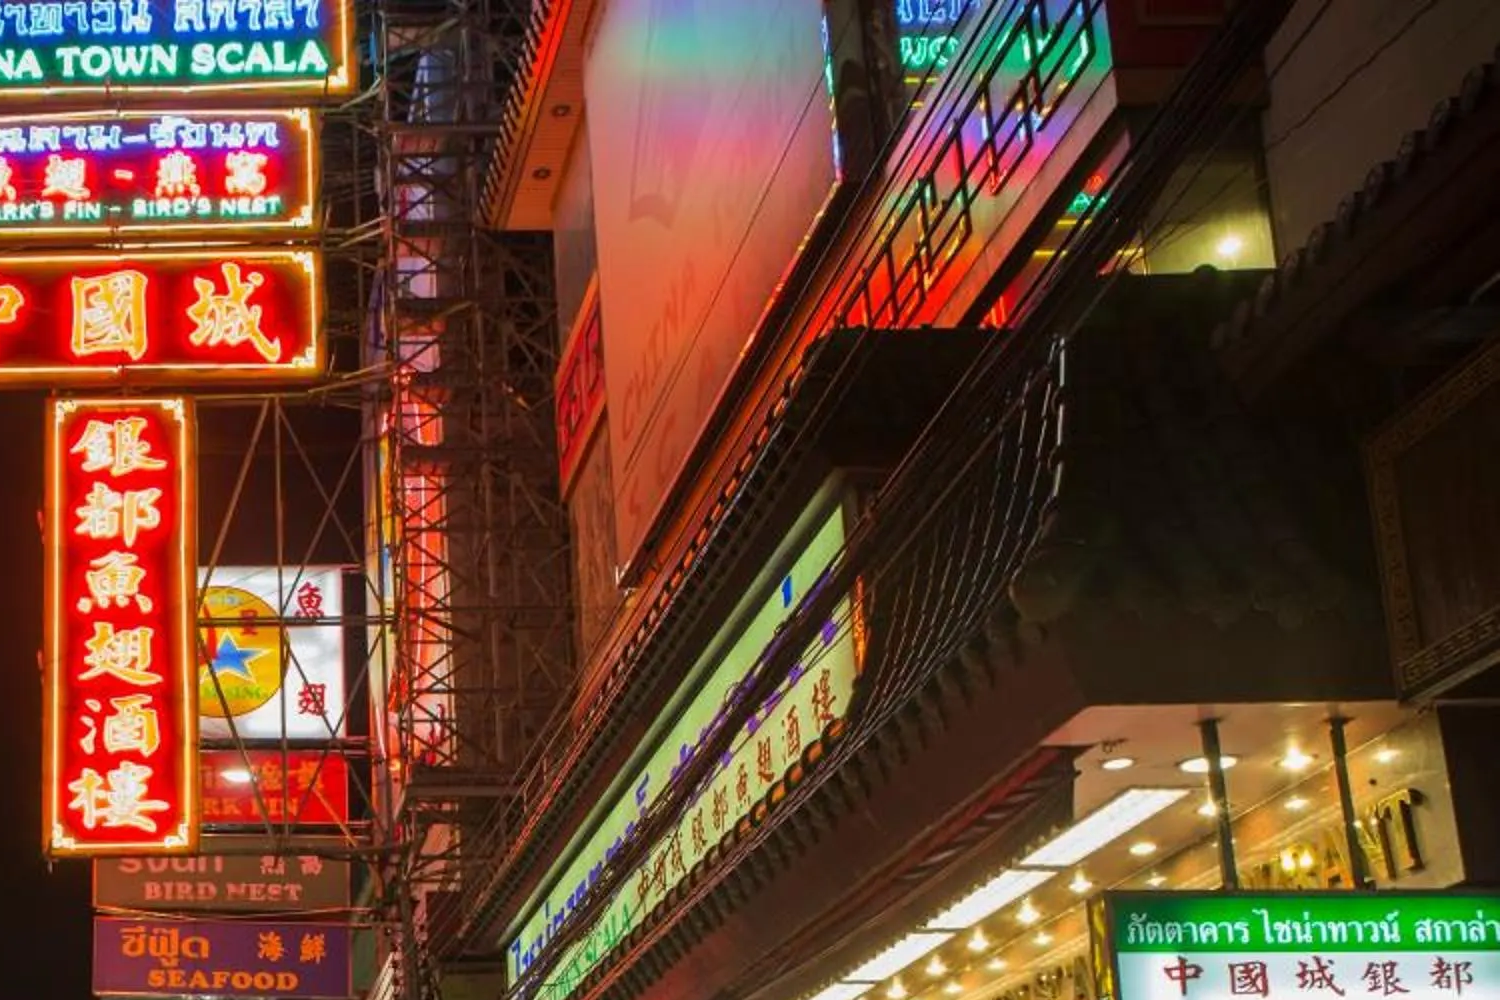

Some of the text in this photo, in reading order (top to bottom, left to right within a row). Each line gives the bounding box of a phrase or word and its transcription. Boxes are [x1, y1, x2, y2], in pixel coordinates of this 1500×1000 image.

[55, 45, 178, 77] TOWN
[190, 41, 328, 75] SCALA
[64, 202, 100, 219] FIN
[133, 197, 211, 217] BIRD'S
[220, 196, 281, 215] NEST
[68, 417, 169, 832] 銀都魚翅酒樓
[145, 882, 303, 900] BIRD NEST
[1126, 909, 1500, 944] ภัตตาคาร ไชน่าทาวน์ สกาล่า
[258, 931, 326, 963] 海鮮
[148, 971, 299, 990] SEAFOOD
[1164, 955, 1473, 997] 中國城銀都
